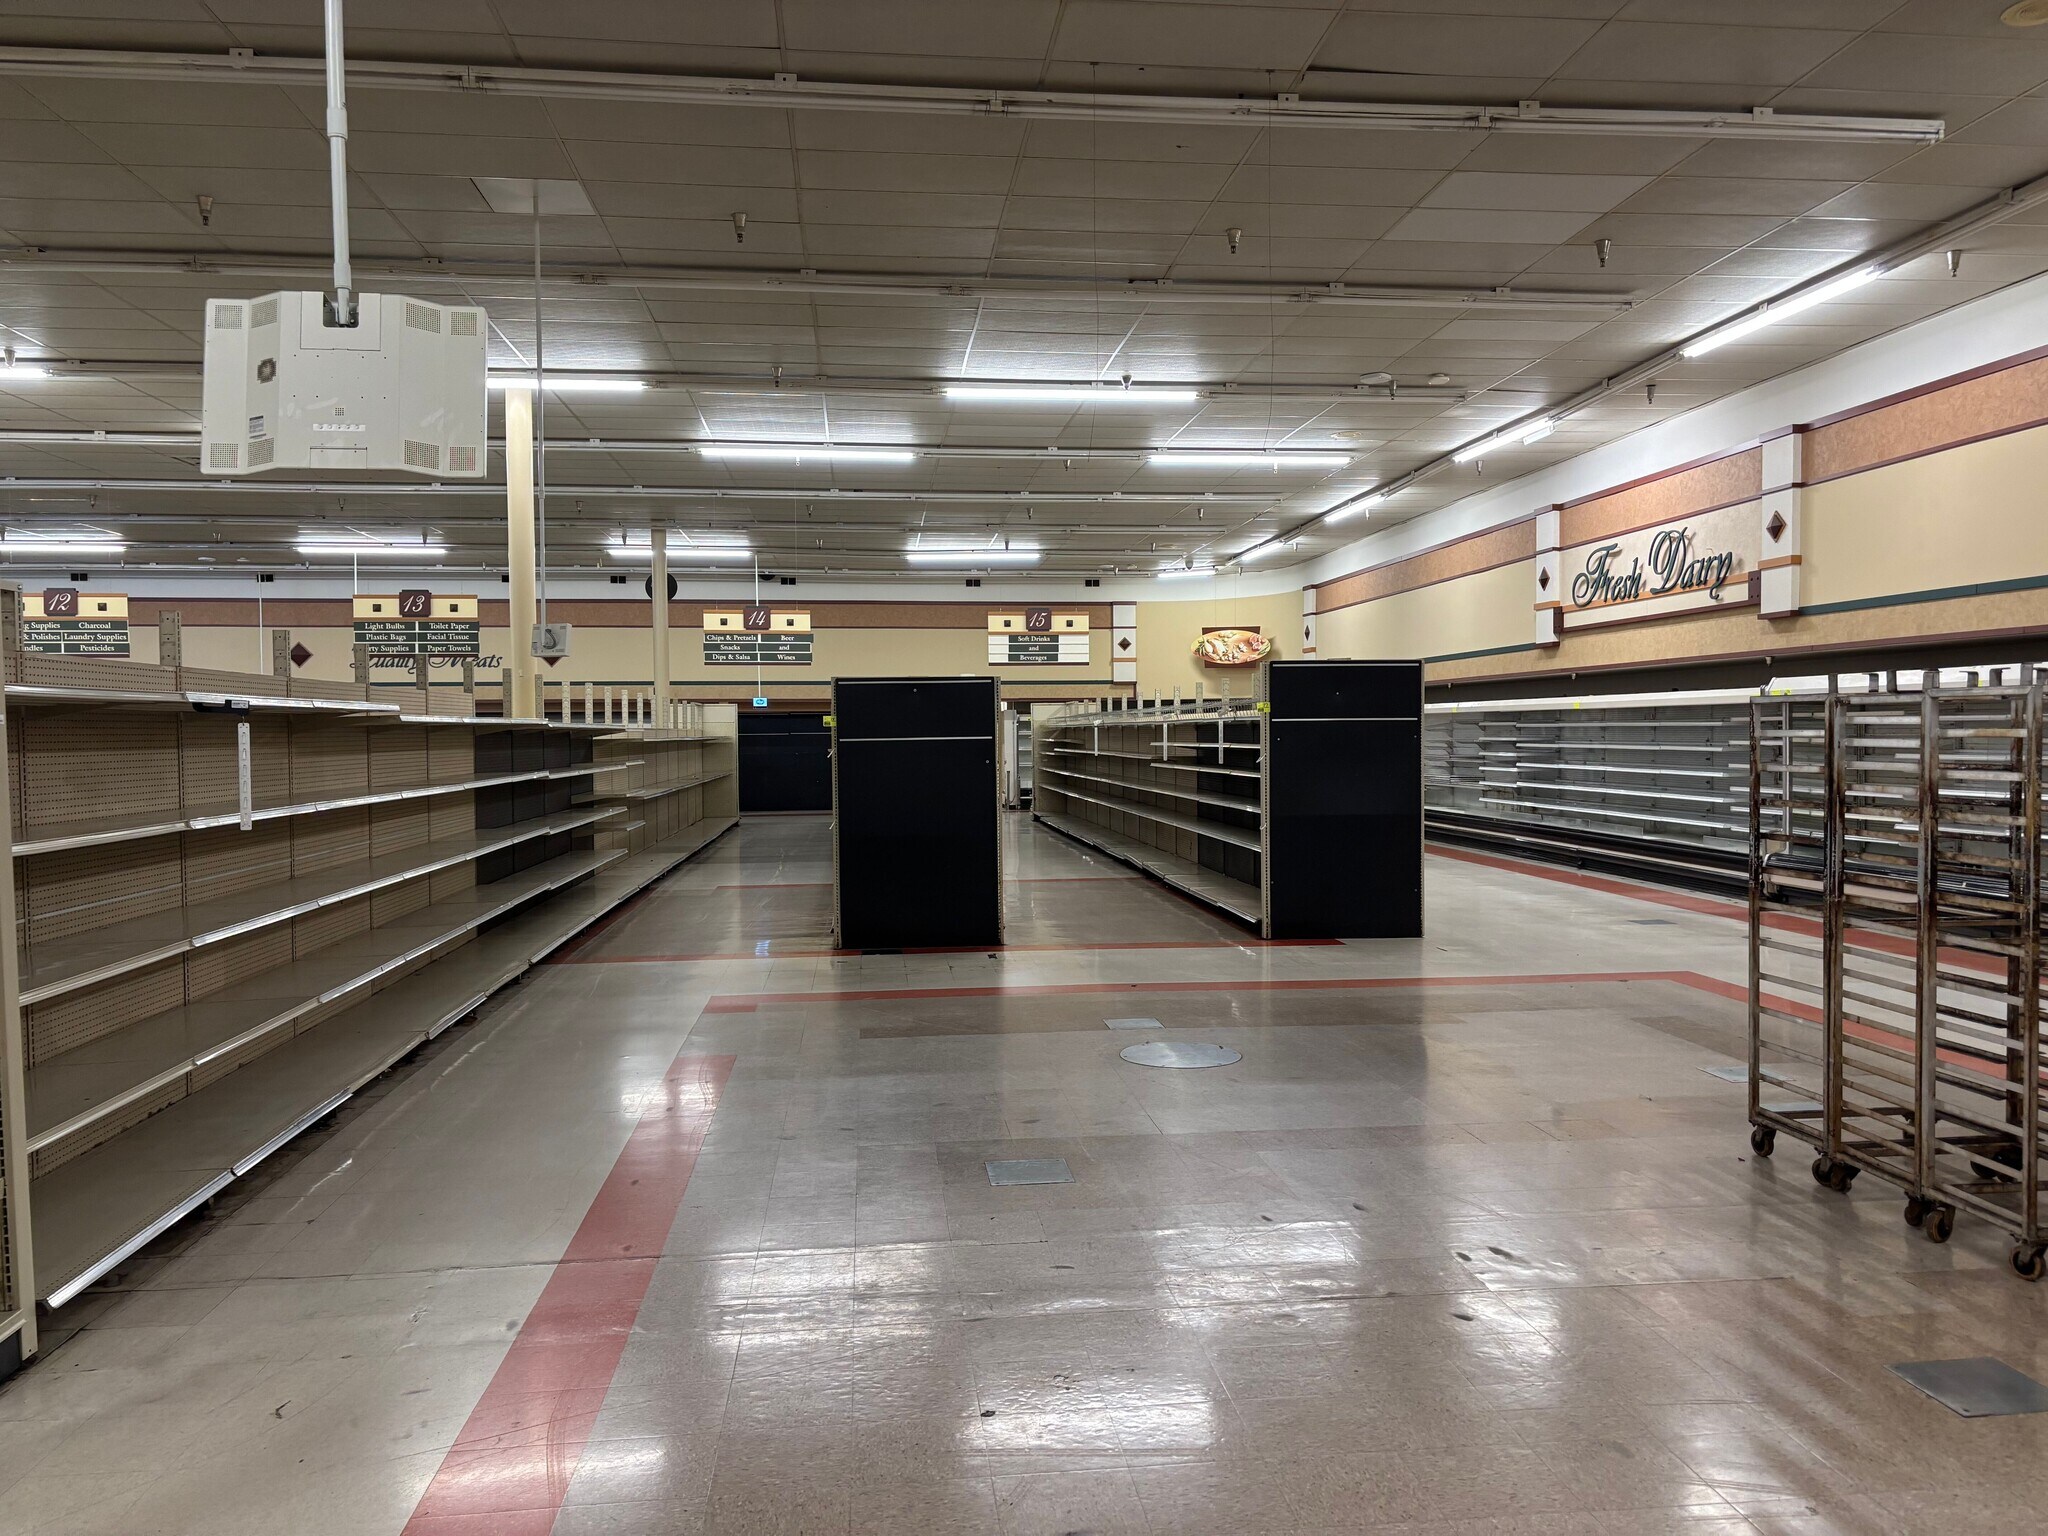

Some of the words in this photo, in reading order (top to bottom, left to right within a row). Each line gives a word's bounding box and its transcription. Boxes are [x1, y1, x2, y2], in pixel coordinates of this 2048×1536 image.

[1572, 542, 1642, 608] Fresh
[1648, 526, 1733, 600] Dairy
[48, 592, 72, 611] 12
[403, 594, 425, 613] 13
[748, 610, 766, 626] 14
[1029, 612, 1048, 627] 15
[30, 621, 61, 631] Supplies
[78, 621, 112, 629] Charcoal
[364, 622, 384, 631] Light
[385, 622, 405, 630] Bulbs
[428, 622, 449, 630] Toilet
[450, 622, 470, 631] Paper
[31, 632, 61, 640] Polishes
[64, 631, 94, 641] Laundry
[96, 631, 127, 641] Supplies
[390, 633, 407, 642] Bags
[706, 634, 725, 643] Chips
[24, 644, 44, 652] ndles
[80, 644, 115, 652] Pesticides
[380, 644, 410, 654] Supplies
[427, 644, 447, 654] Paper
[447, 644, 472, 652] Towels
[712, 653, 727, 662] Dips
[1019, 654, 1048, 663] Beverages
